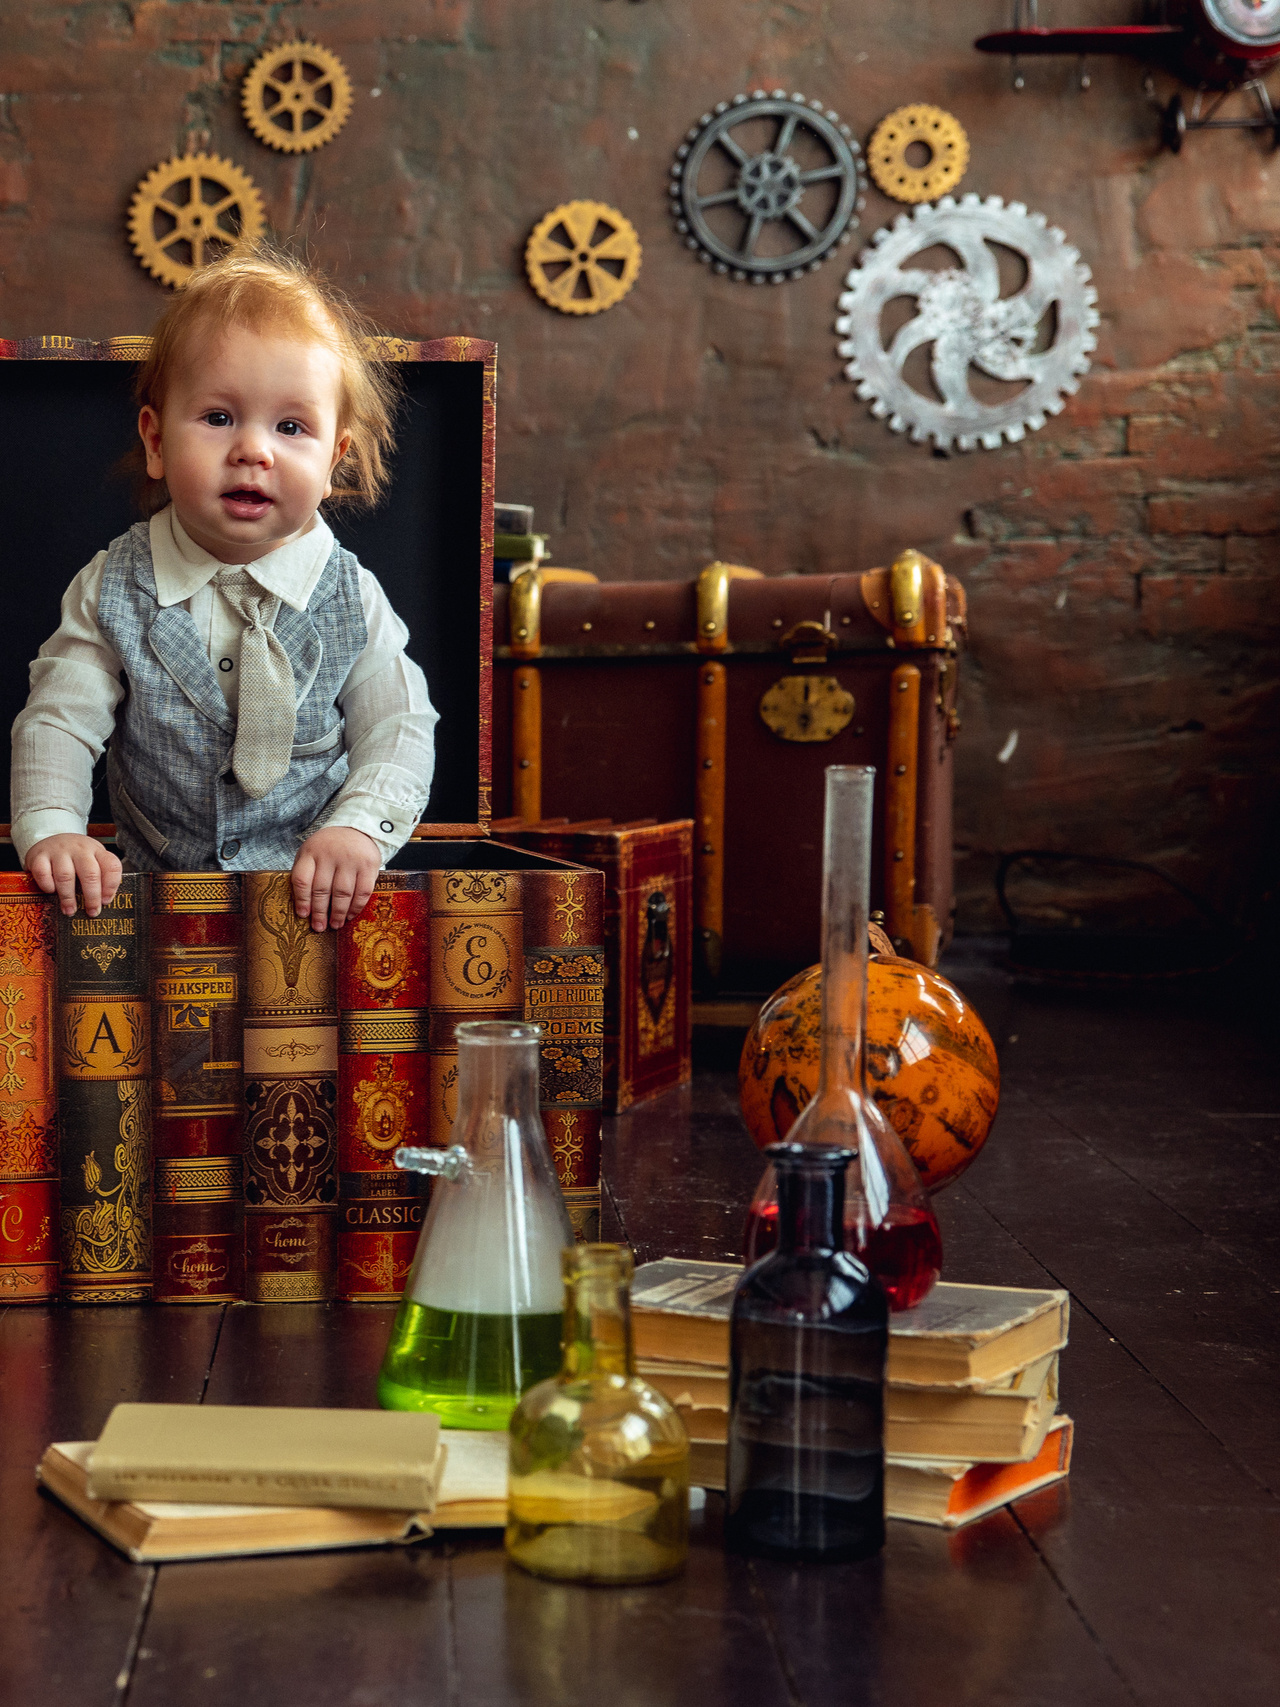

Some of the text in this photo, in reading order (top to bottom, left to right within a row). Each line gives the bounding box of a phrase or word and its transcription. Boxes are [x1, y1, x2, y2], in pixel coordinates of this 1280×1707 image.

[375, 882, 397, 890] ABEL
[71, 918, 135, 936] SHAKESPEARE
[158, 982, 233, 996] SHAKSPERE
[84, 1011, 126, 1053] A
[345, 1206, 421, 1225] CLASSIC
[266, 1232, 317, 1248] home
[174, 1257, 225, 1273] home
